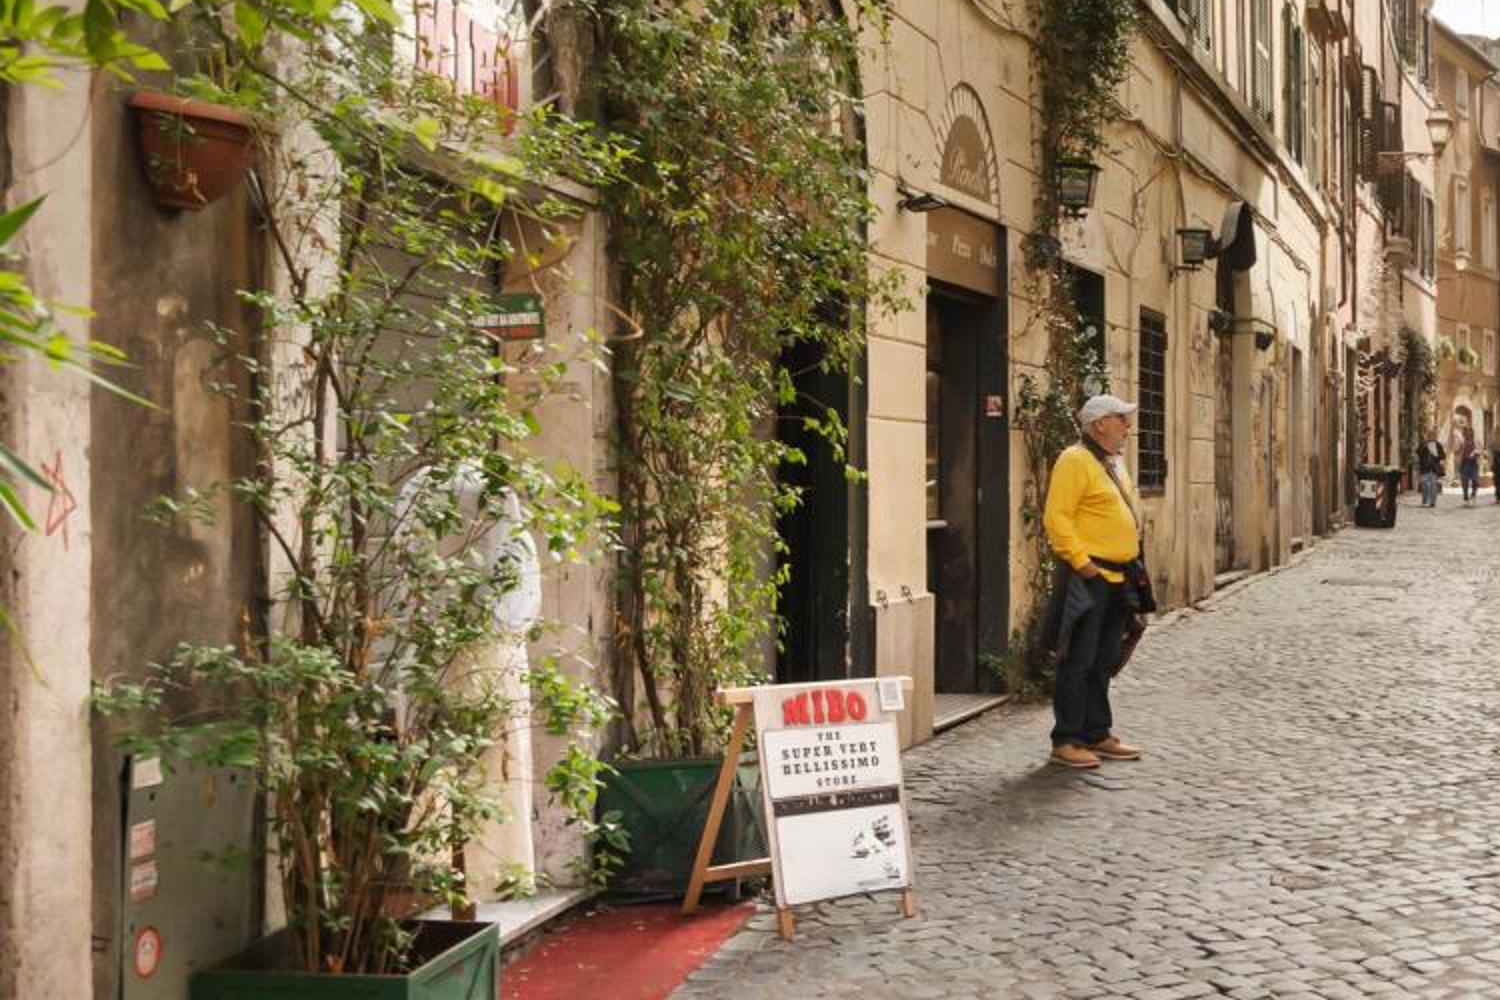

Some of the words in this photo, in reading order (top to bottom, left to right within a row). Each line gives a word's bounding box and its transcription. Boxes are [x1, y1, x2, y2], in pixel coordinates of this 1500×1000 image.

[816, 731, 842, 742] THE
[782, 745, 833, 760] SUPER
[782, 756, 880, 776] BELLISSIMO
[815, 775, 858, 787] STORE
